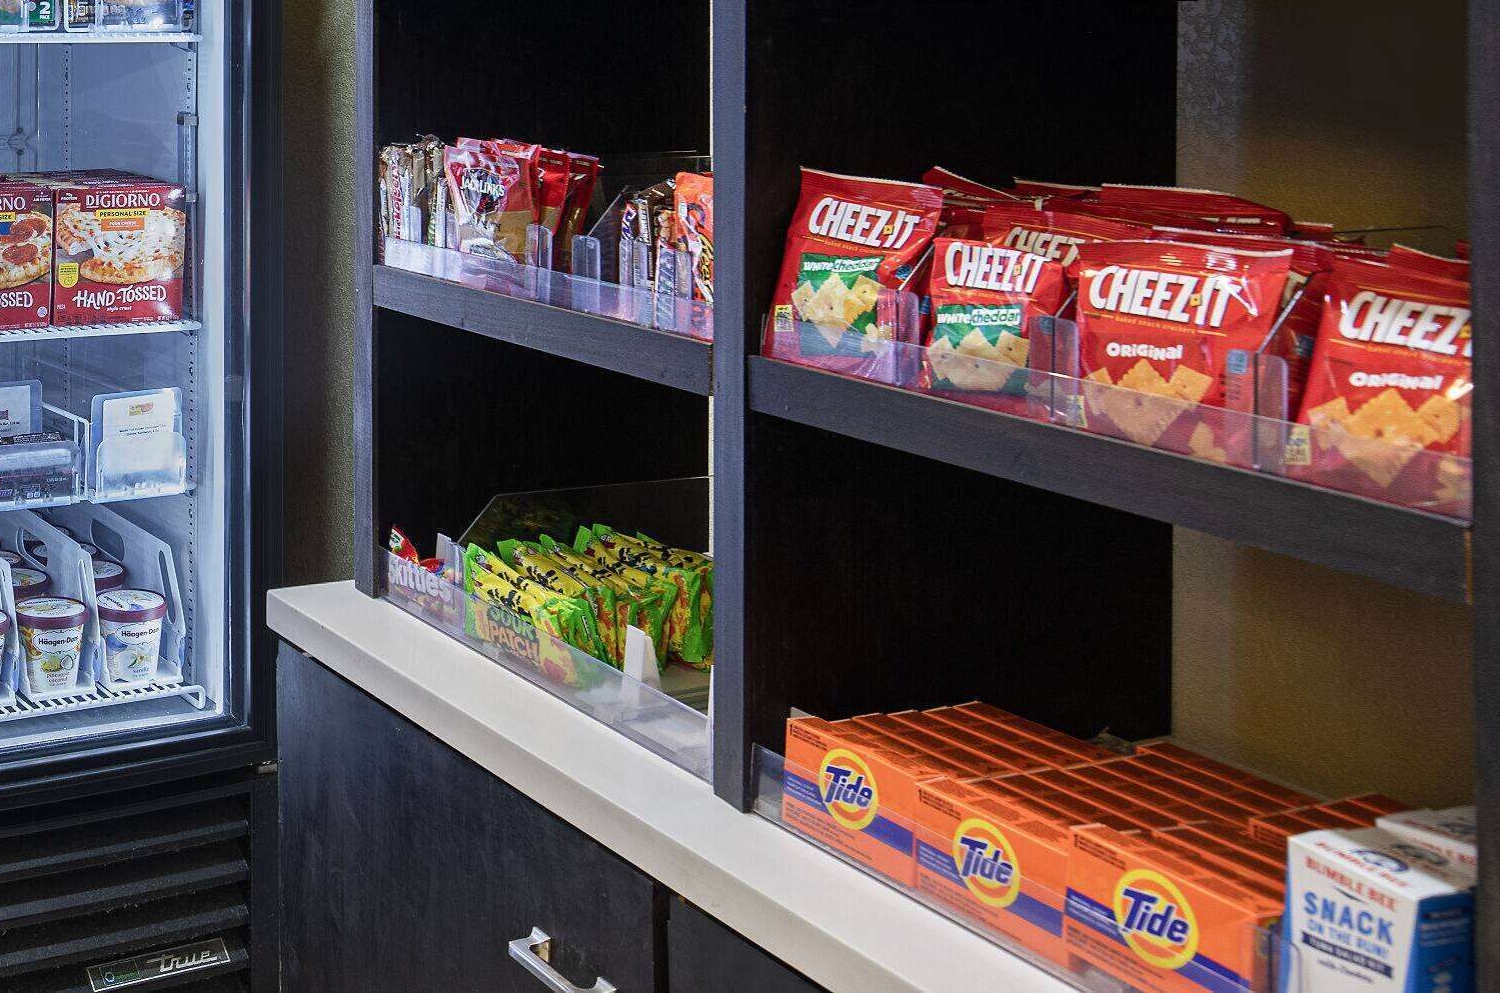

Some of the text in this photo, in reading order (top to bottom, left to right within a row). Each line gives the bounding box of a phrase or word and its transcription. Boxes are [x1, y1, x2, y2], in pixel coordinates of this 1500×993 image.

[39, 1, 51, 15] 2
[99, 210, 132, 218] PERSONAL
[808, 196, 921, 250] CHEEZ-IT
[803, 257, 879, 273] WHITE cheddar
[944, 240, 1054, 294] CHEEZ-IT
[72, 285, 167, 309] HAND-TOSSED
[936, 309, 1021, 326] WHITE cheddar
[1089, 265, 1241, 329] CHEEZ-IT
[490, 621, 540, 659] PATCH
[824, 763, 874, 809] Tide
[958, 835, 1014, 887] Tide
[1304, 855, 1397, 912] BUMBLE BEE
[1122, 887, 1191, 945] Tide
[1303, 891, 1394, 946] SNACK
[1327, 926, 1351, 946] THE
